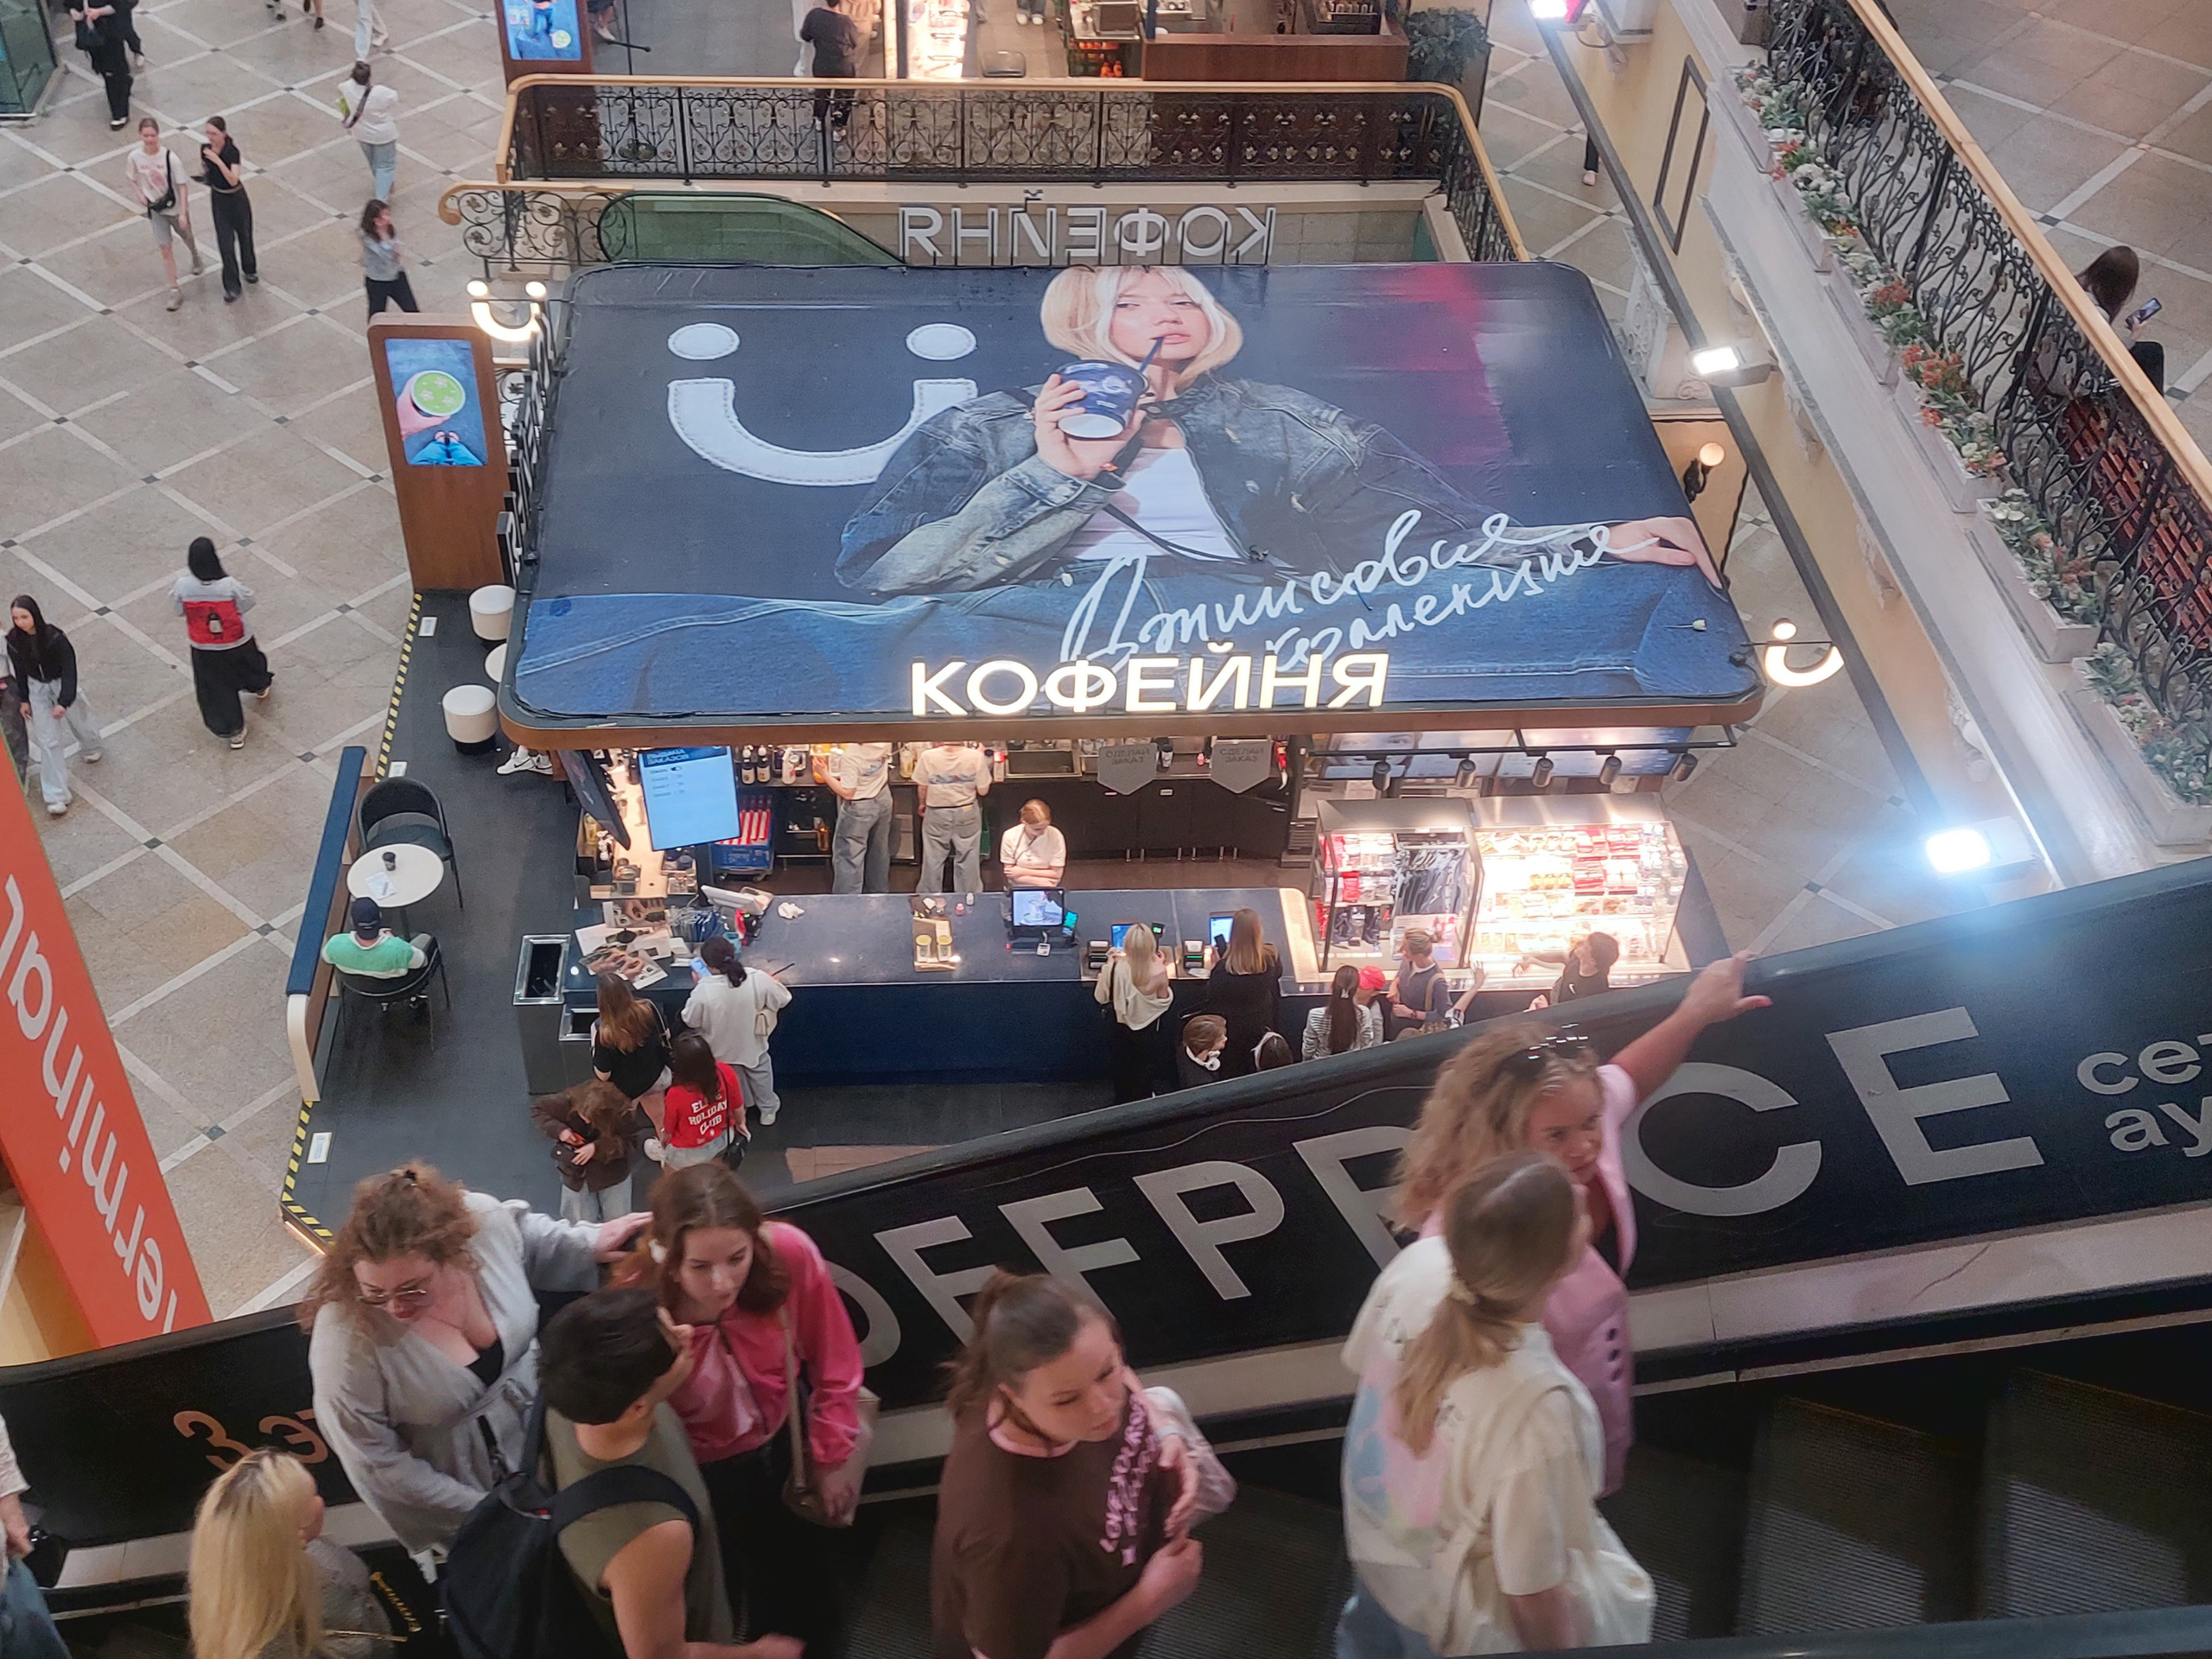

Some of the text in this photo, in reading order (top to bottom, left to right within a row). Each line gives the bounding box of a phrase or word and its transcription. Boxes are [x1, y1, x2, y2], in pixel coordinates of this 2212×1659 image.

[912, 641, 1389, 716] КОФЕЙНЯ
[688, 1099, 728, 1126] HOLIDAY
[699, 1114, 722, 1135] CLUB
